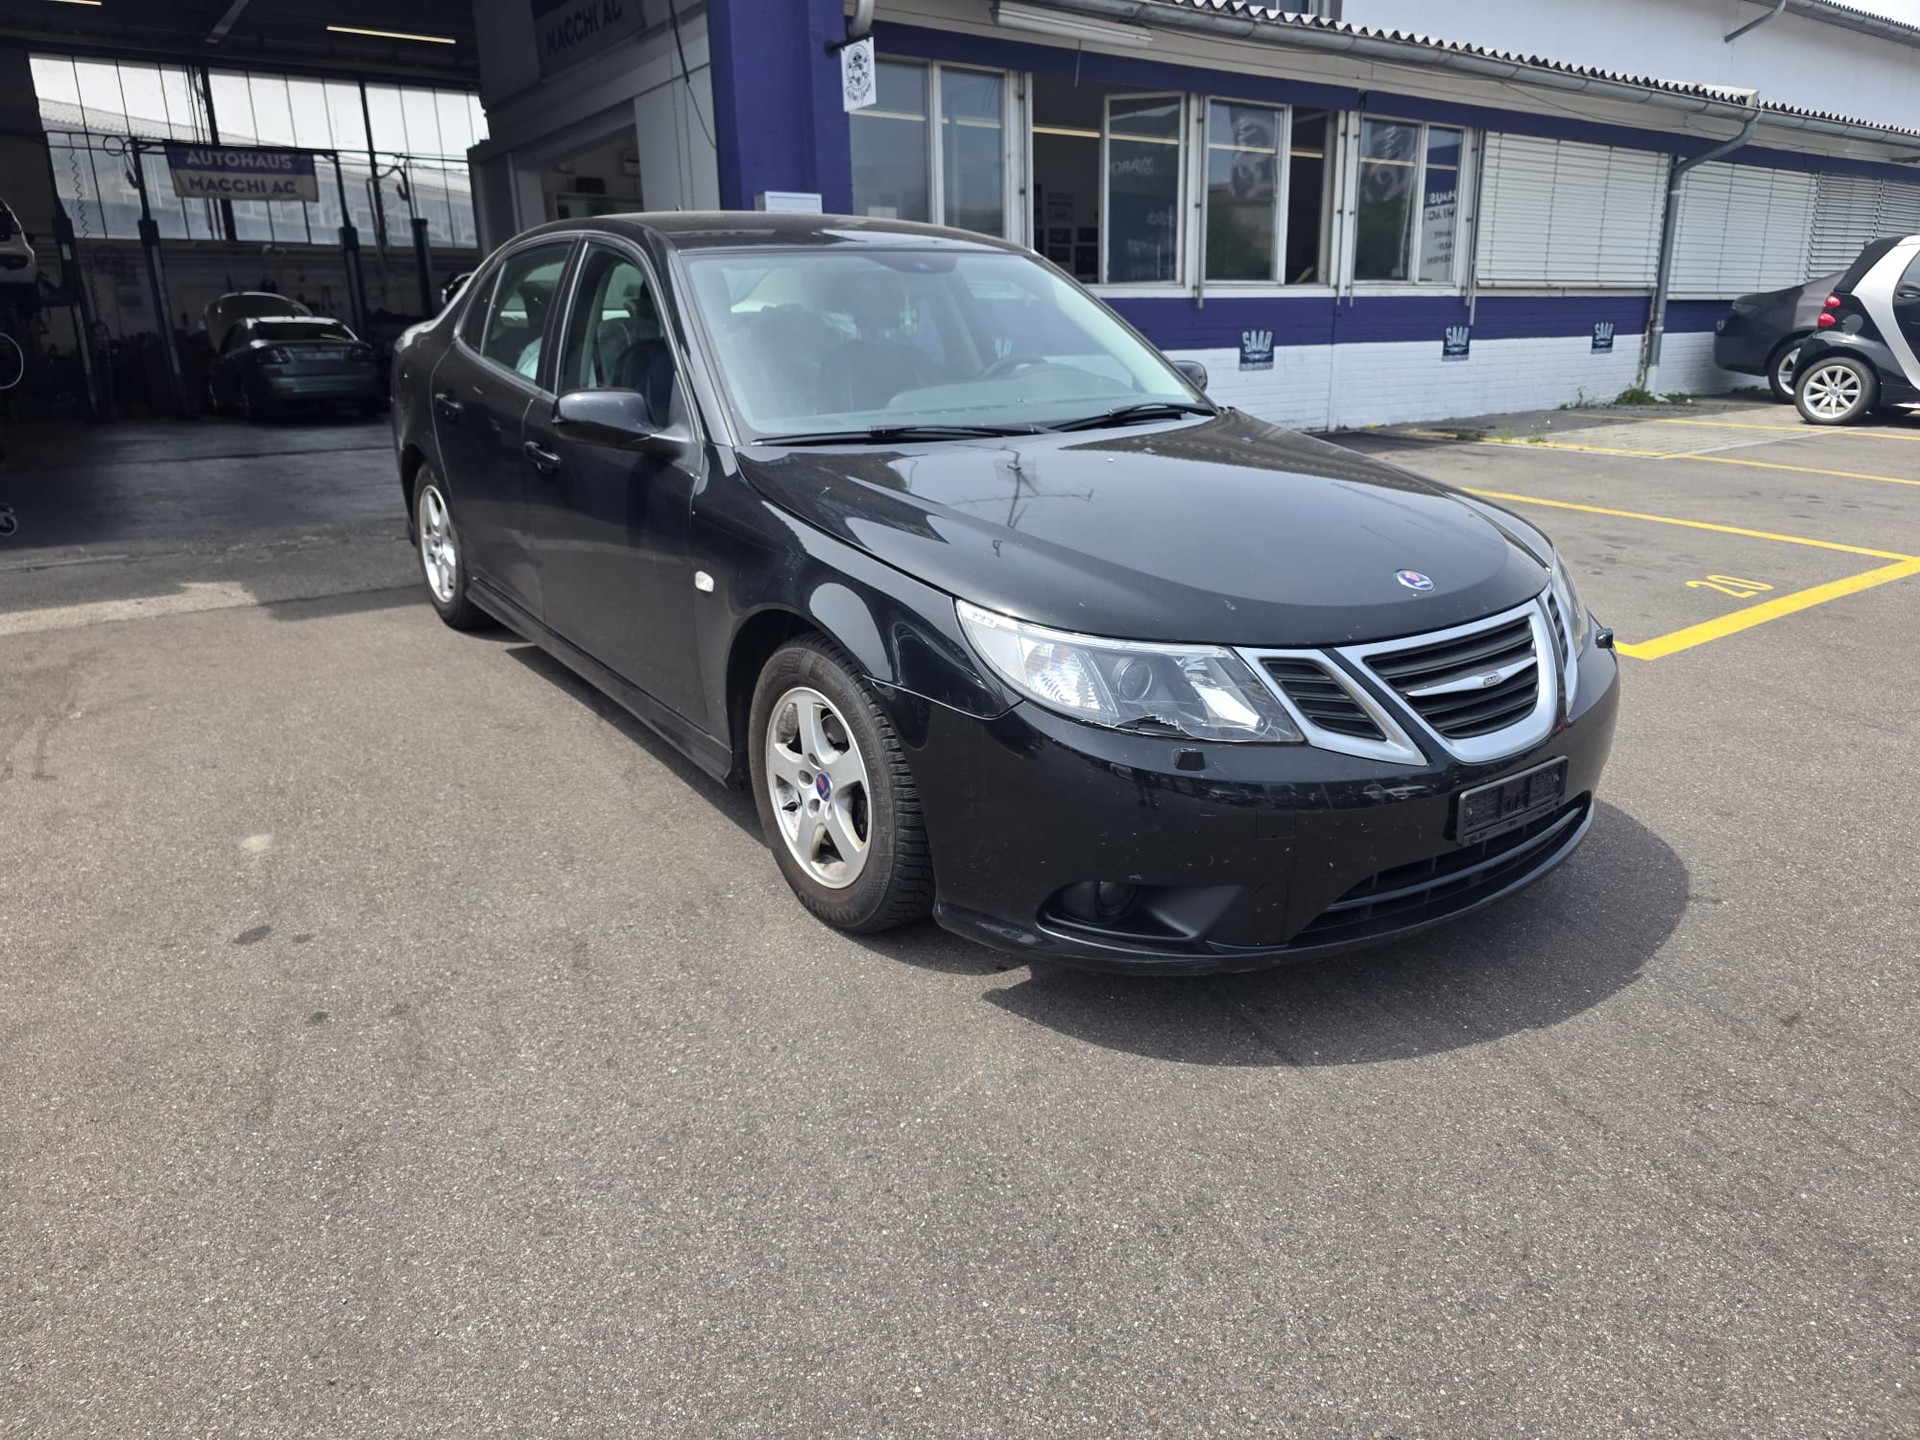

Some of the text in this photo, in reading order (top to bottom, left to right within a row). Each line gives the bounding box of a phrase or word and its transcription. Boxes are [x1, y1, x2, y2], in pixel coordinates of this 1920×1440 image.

[186, 150, 293, 169] AUTOHAUS
[188, 176, 267, 194] MACCHI
[1242, 329, 1273, 353] SAAB
[1685, 574, 1774, 598] 20
